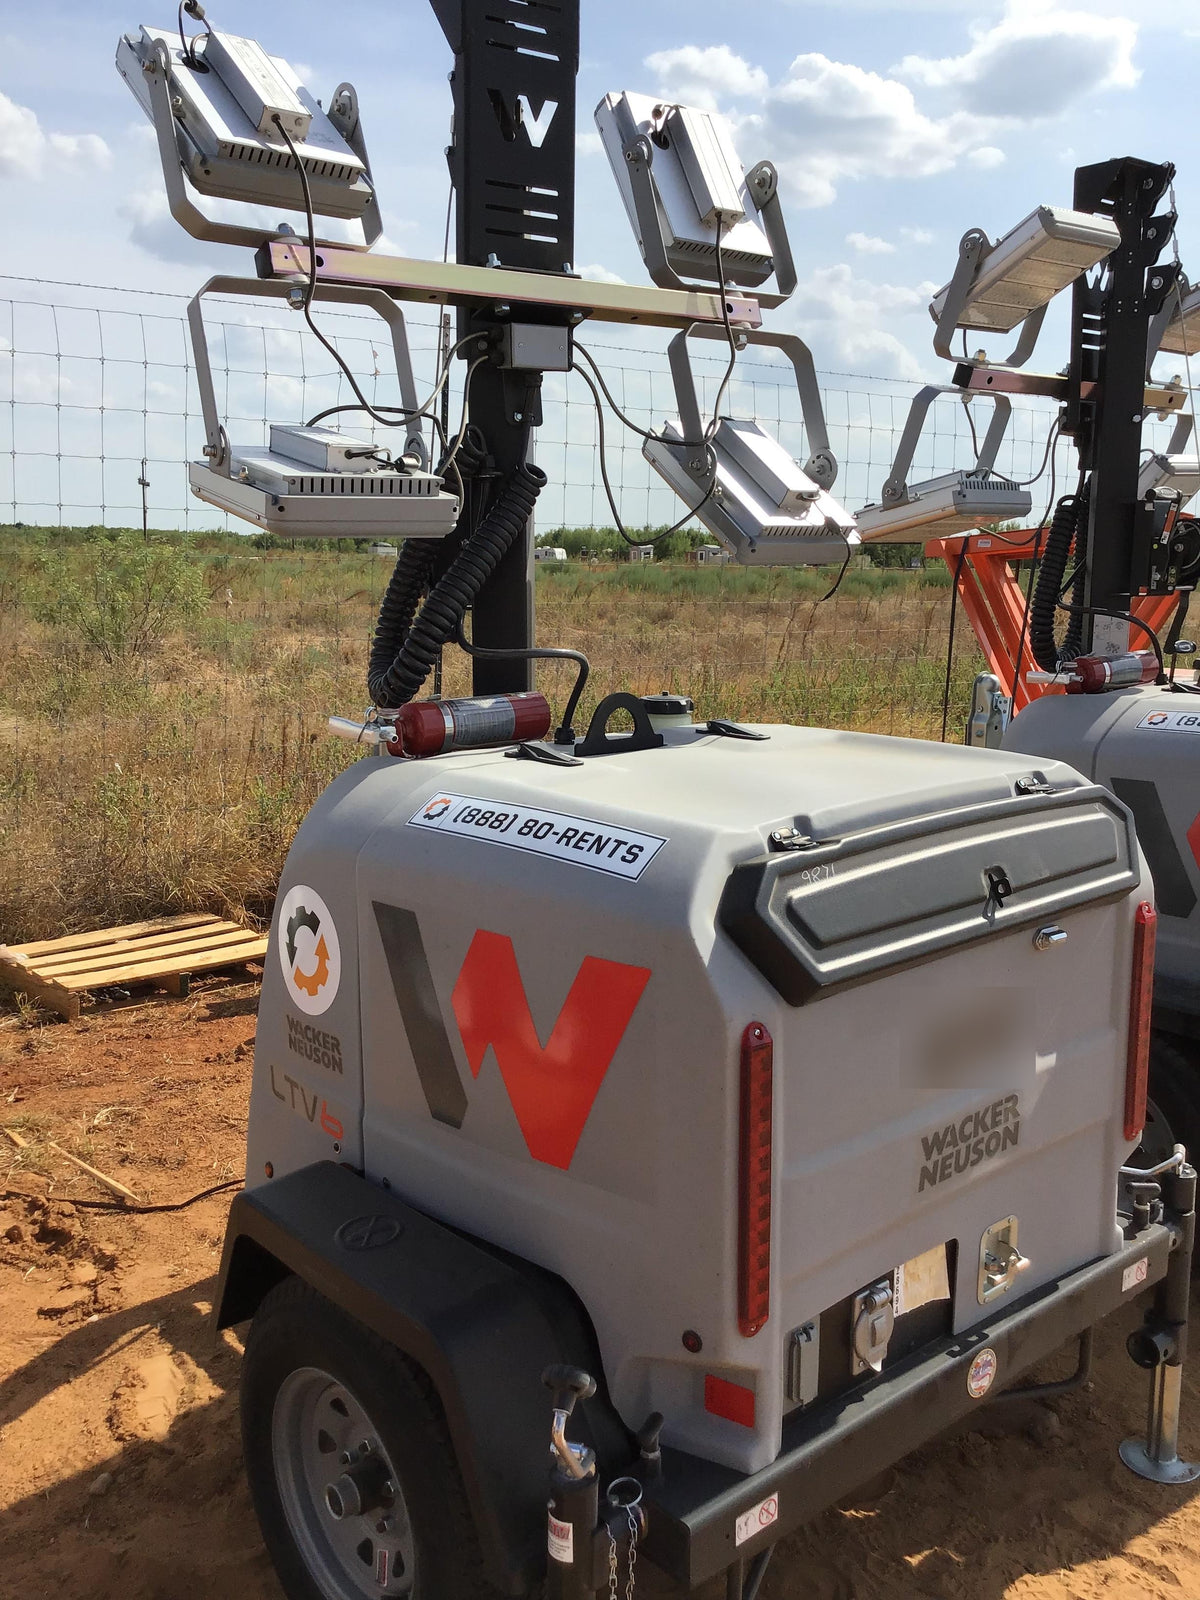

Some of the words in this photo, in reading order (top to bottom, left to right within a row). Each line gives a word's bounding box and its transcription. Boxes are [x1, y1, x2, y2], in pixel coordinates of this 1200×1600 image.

[452, 805, 518, 833] (888)
[517, 818, 645, 864] 80-RENTS
[801, 863, 835, 884] 9871
[286, 1014, 342, 1056] WACKER
[288, 1033, 344, 1075] NEUSON
[270, 1065, 344, 1140] LTV6
[920, 1093, 1021, 1161] WACKER
[918, 1120, 1021, 1192] NEUSON
